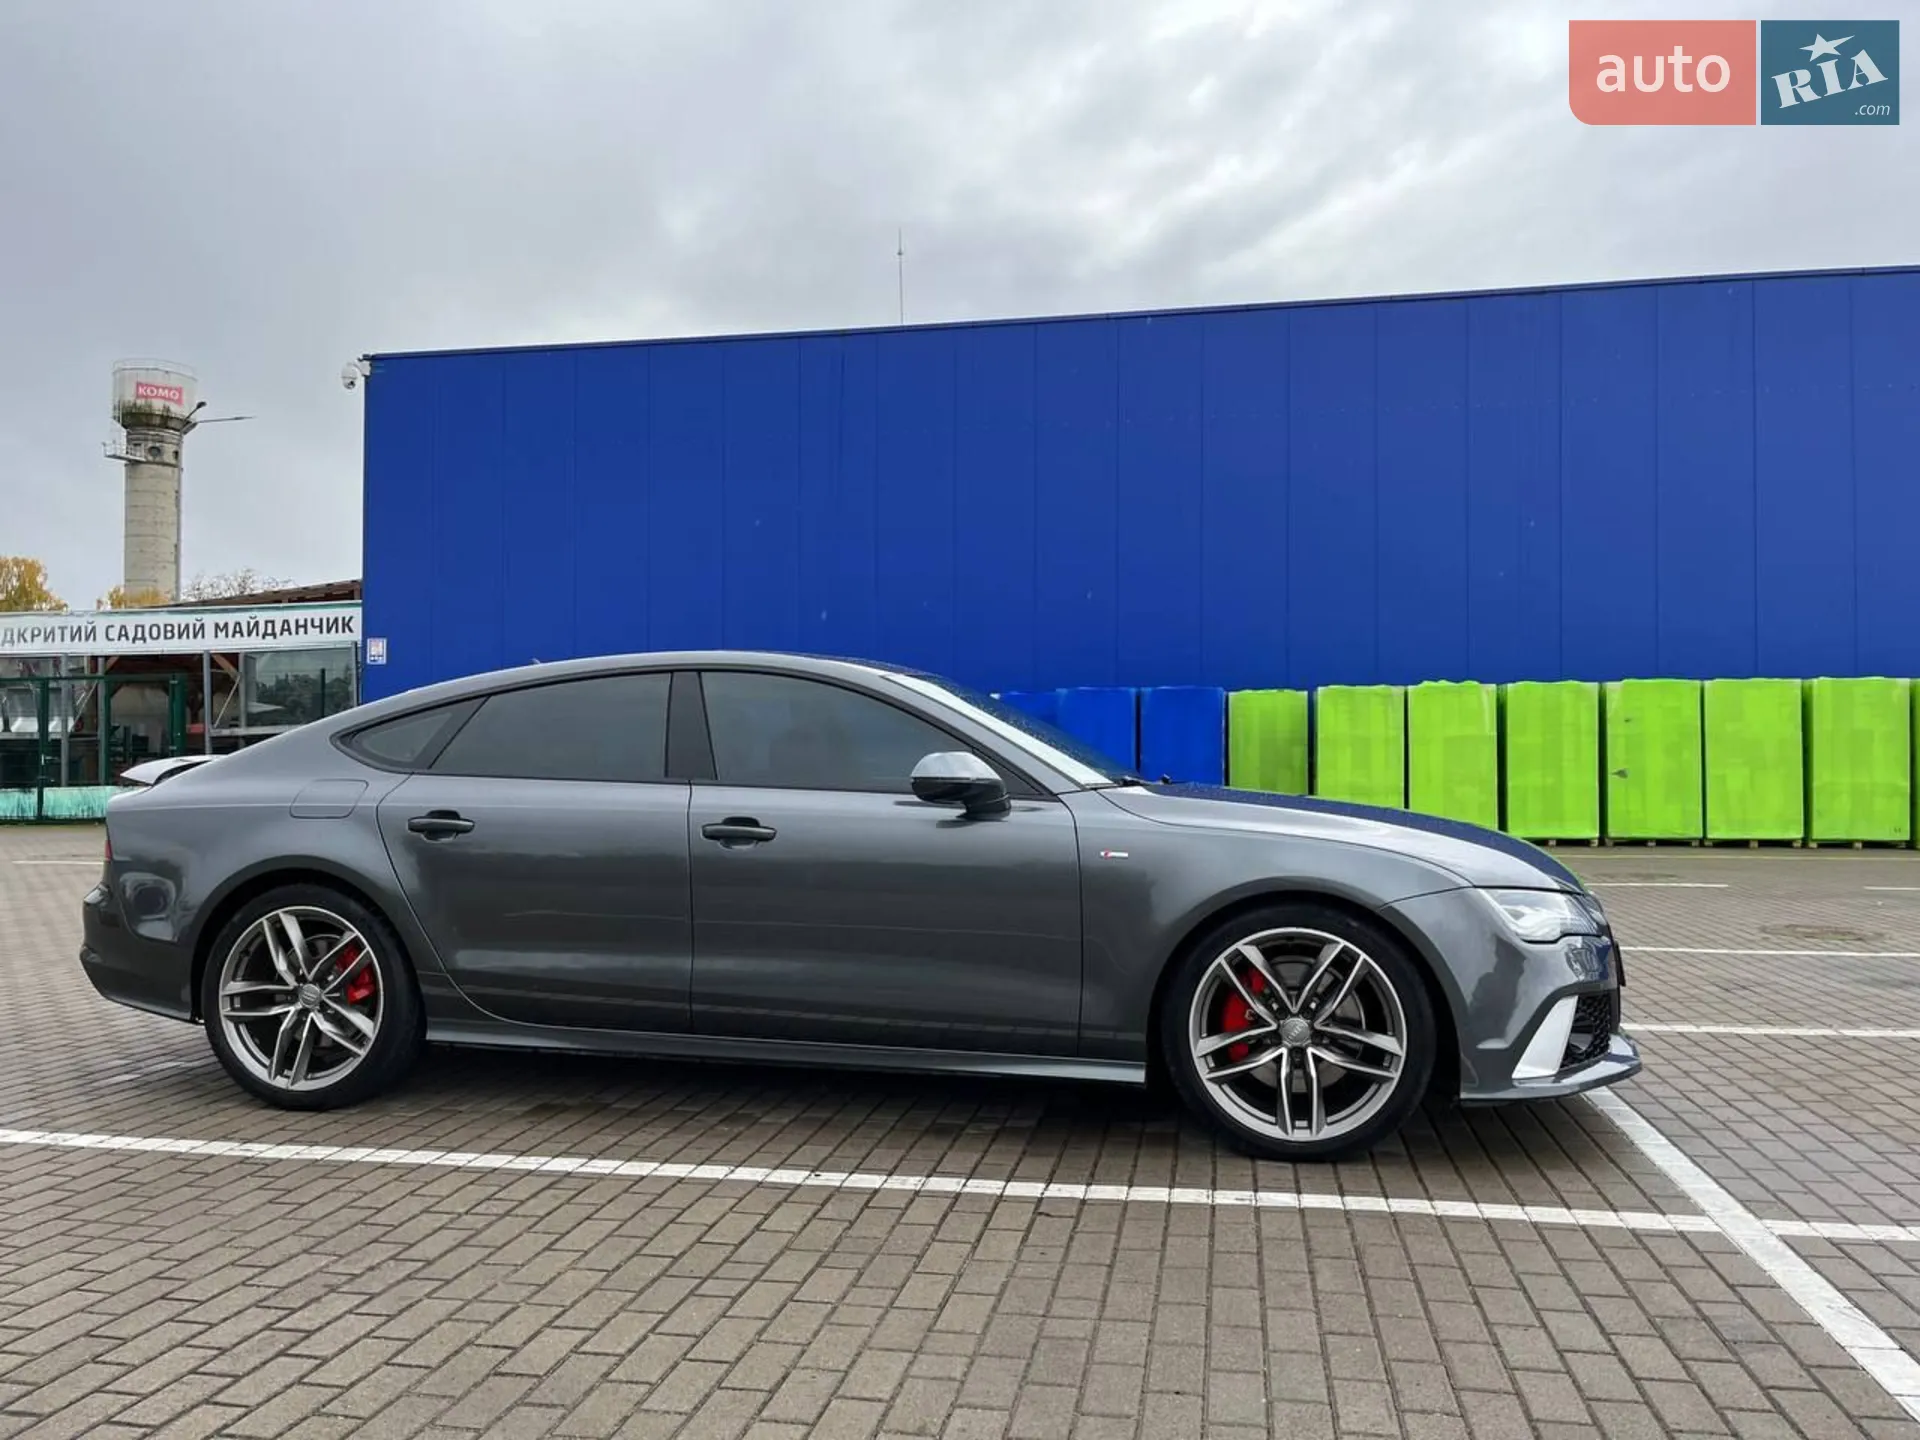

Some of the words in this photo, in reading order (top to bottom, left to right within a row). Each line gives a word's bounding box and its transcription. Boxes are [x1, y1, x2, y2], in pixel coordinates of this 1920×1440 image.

[1, 621, 97, 647] ДКРИТИЙ
[105, 618, 206, 644] САДОВИЙ
[213, 615, 355, 640] МАЙДАНЧИК
